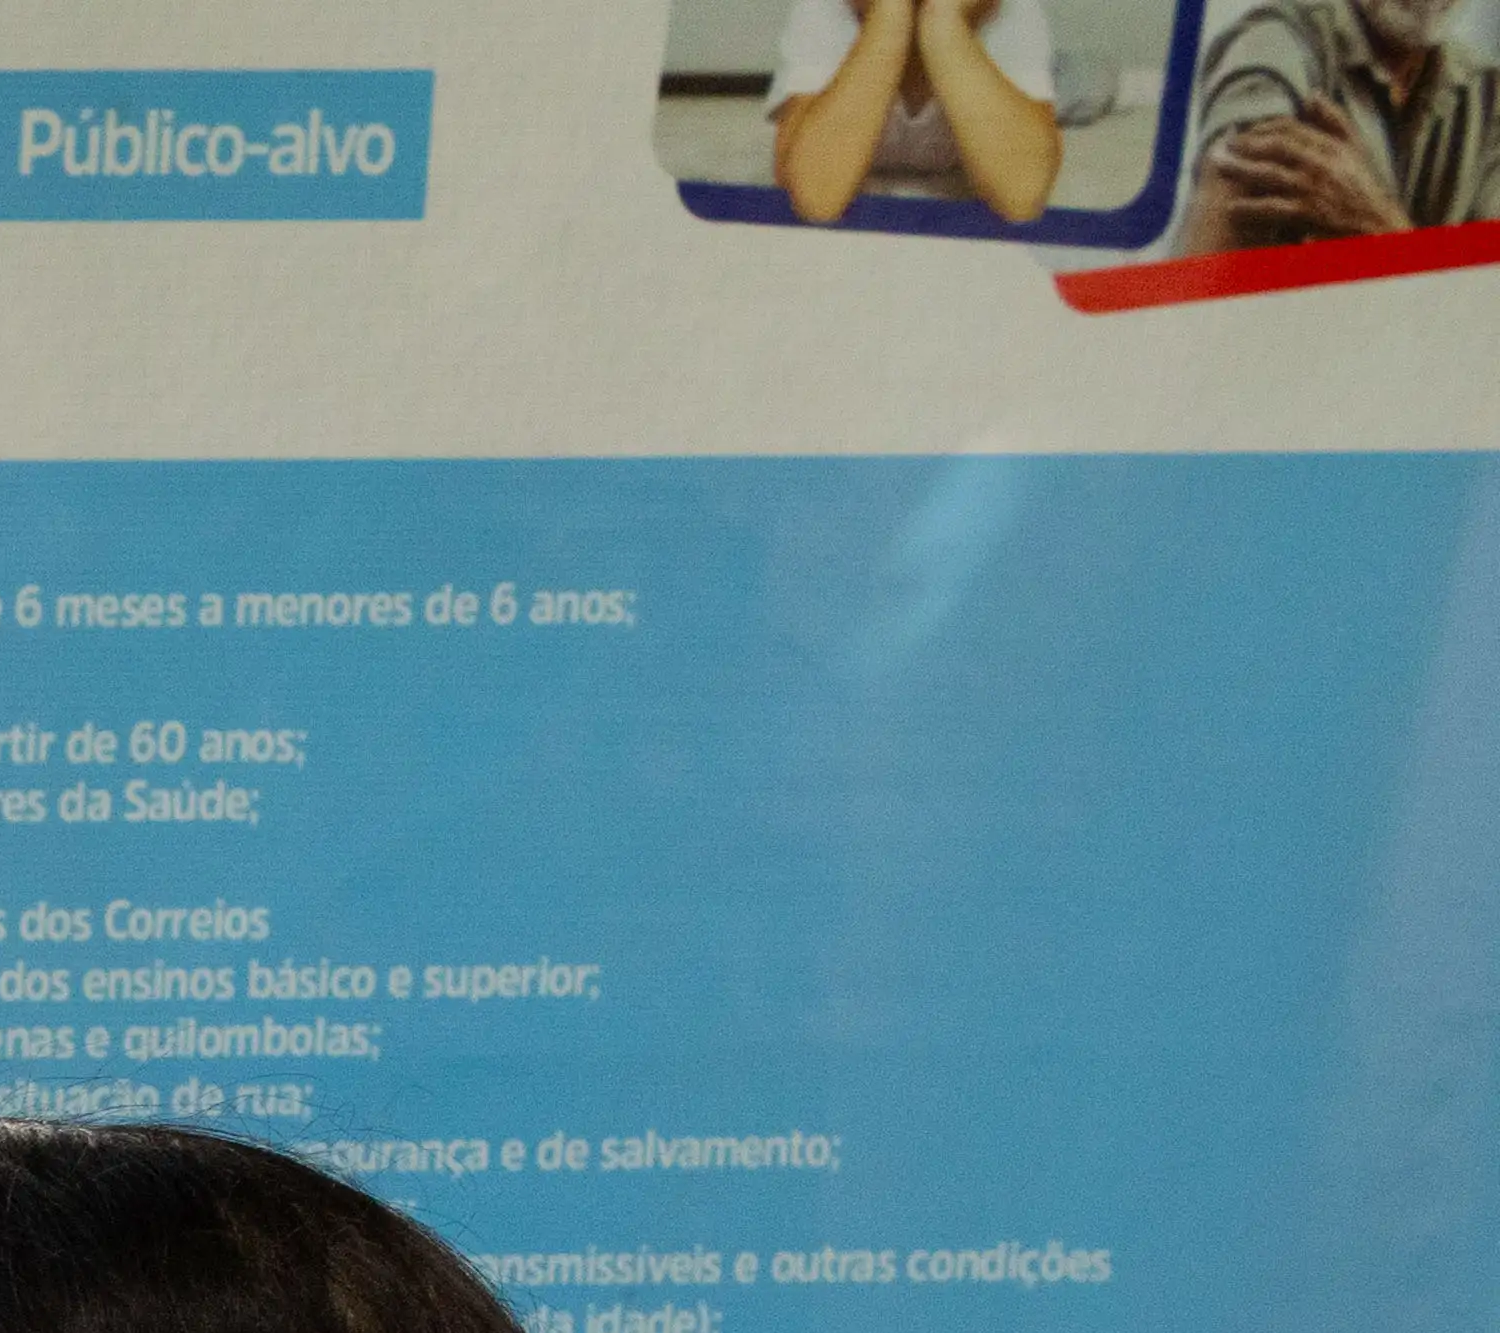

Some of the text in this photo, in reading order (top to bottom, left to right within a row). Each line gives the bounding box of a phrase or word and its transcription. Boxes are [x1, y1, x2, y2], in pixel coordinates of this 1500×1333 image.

[18, 107, 396, 178] Público-alvo
[14, 584, 43, 628] 6
[54, 592, 187, 629] meses
[198, 592, 225, 627] a
[235, 591, 413, 628] menores
[423, 584, 479, 627] de
[489, 582, 517, 626] 6
[528, 589, 637, 628] anos;
[66, 722, 118, 764] de
[129, 720, 188, 764] 60
[199, 728, 307, 767] anos;
[57, 781, 112, 824] da
[123, 777, 259, 825] Saúde;
[19, 900, 93, 942] dos
[104, 898, 270, 942] Correios
[81, 960, 236, 1002] ensinos
[247, 957, 377, 1000] básico
[388, 965, 413, 999] e
[424, 957, 601, 1004] superior;
[85, 1025, 110, 1060] e
[123, 1016, 381, 1062] quilombolas;
[170, 1077, 225, 1118] de
[235, 1082, 314, 1122] rua;
[500, 1138, 526, 1171] e
[536, 1131, 590, 1171] de
[601, 1129, 842, 1171] salvamento;
[733, 1251, 759, 1285] e
[771, 1246, 897, 1284] outras
[906, 1240, 1111, 1287] condições
